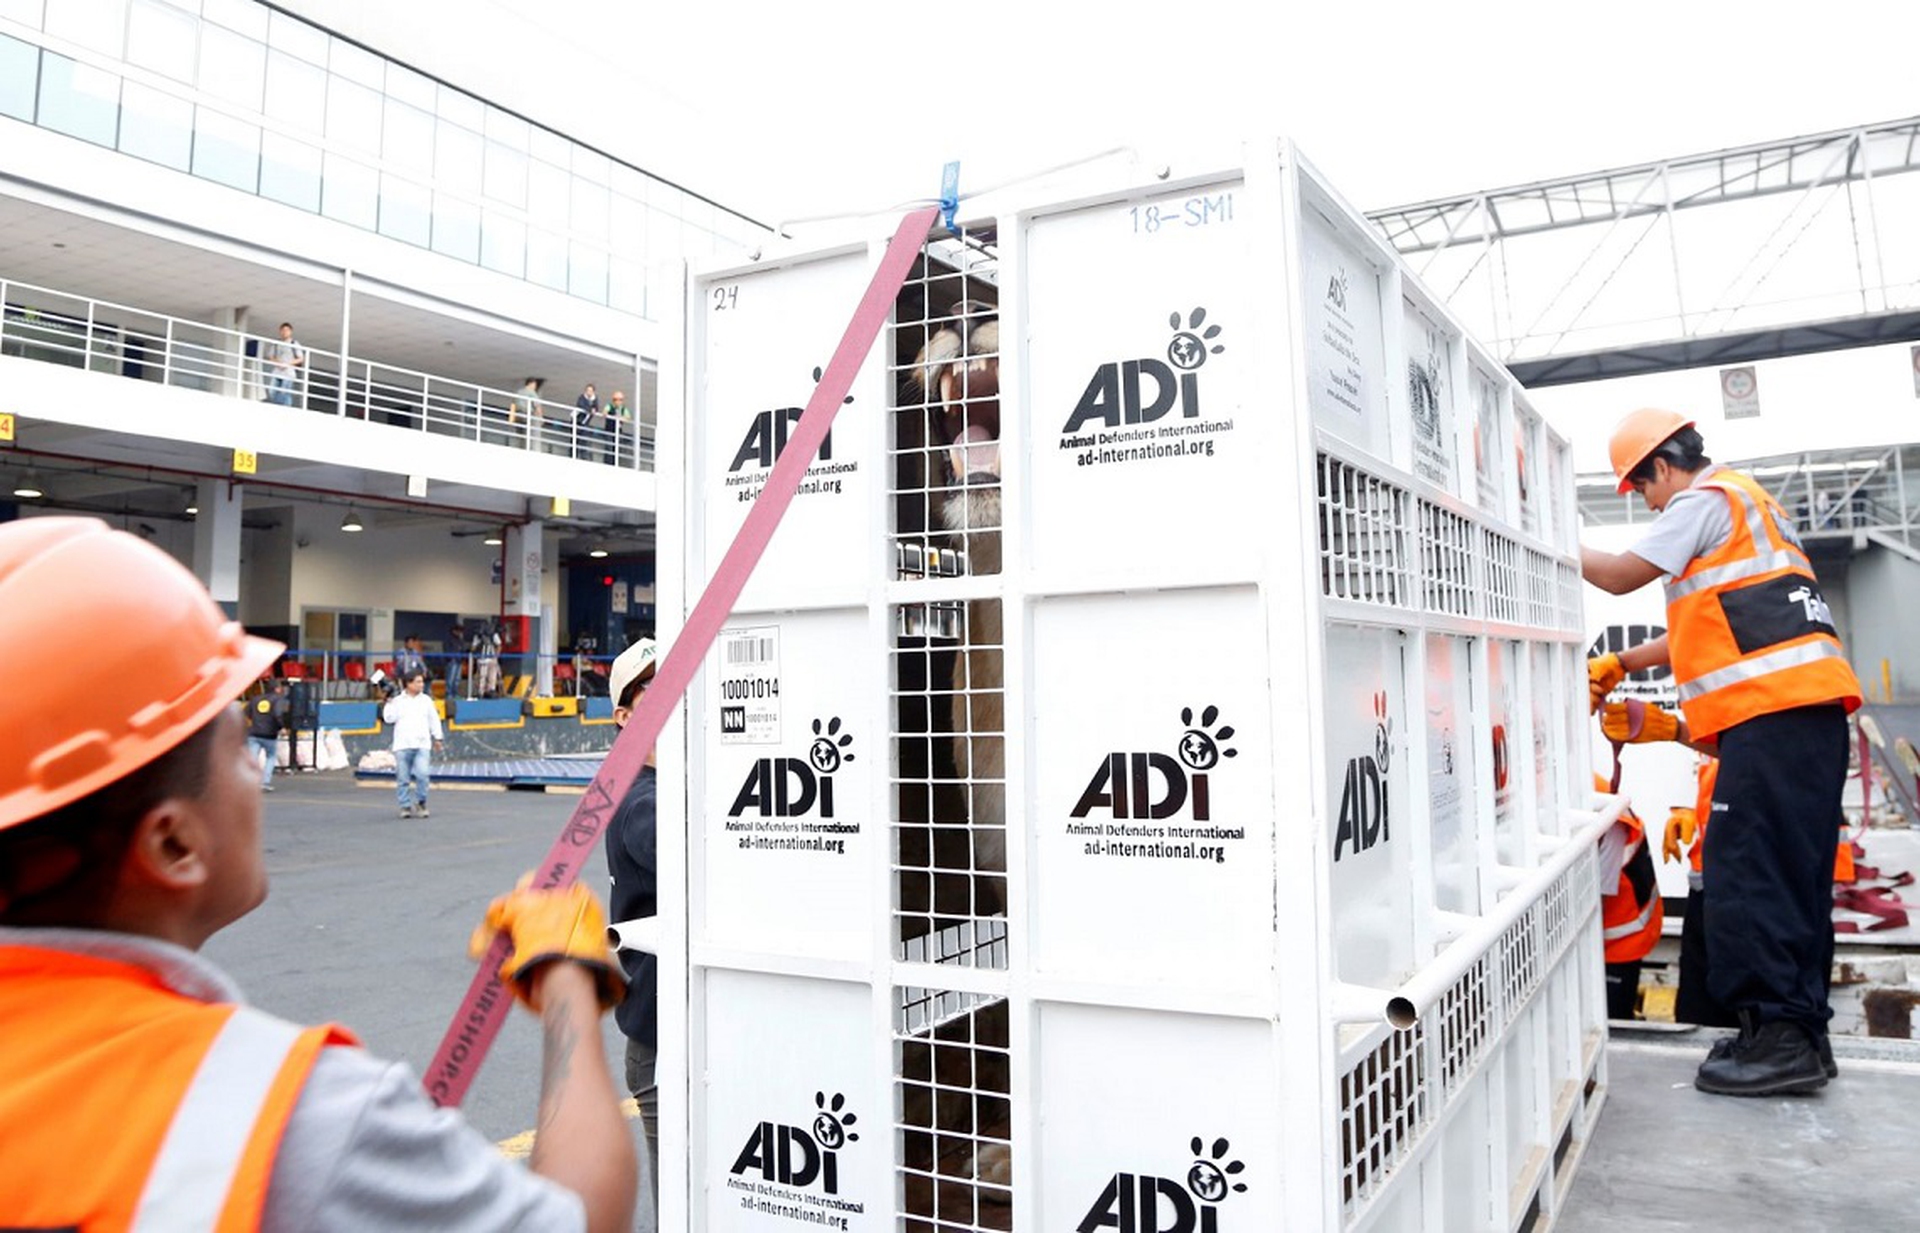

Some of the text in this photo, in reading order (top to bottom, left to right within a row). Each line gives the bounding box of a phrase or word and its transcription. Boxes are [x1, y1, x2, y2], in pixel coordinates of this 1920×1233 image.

[714, 285, 738, 310] 24
[1059, 419, 1233, 449] Animal Defenders International
[237, 453, 253, 468] 35
[1078, 439, 1215, 466] ad-international.org
[725, 475, 753, 486] Animal
[804, 461, 858, 477] ternational
[721, 678, 779, 699] 10001014
[724, 709, 744, 729] NN
[725, 821, 860, 834] Animal Defenders International
[1066, 823, 1245, 839] Animal Defenders International
[739, 835, 844, 854] ad-international.org
[1084, 840, 1225, 863] ad-international.org
[727, 1178, 864, 1213] Animal Defenders International
[740, 1196, 848, 1232] ad-international.org
